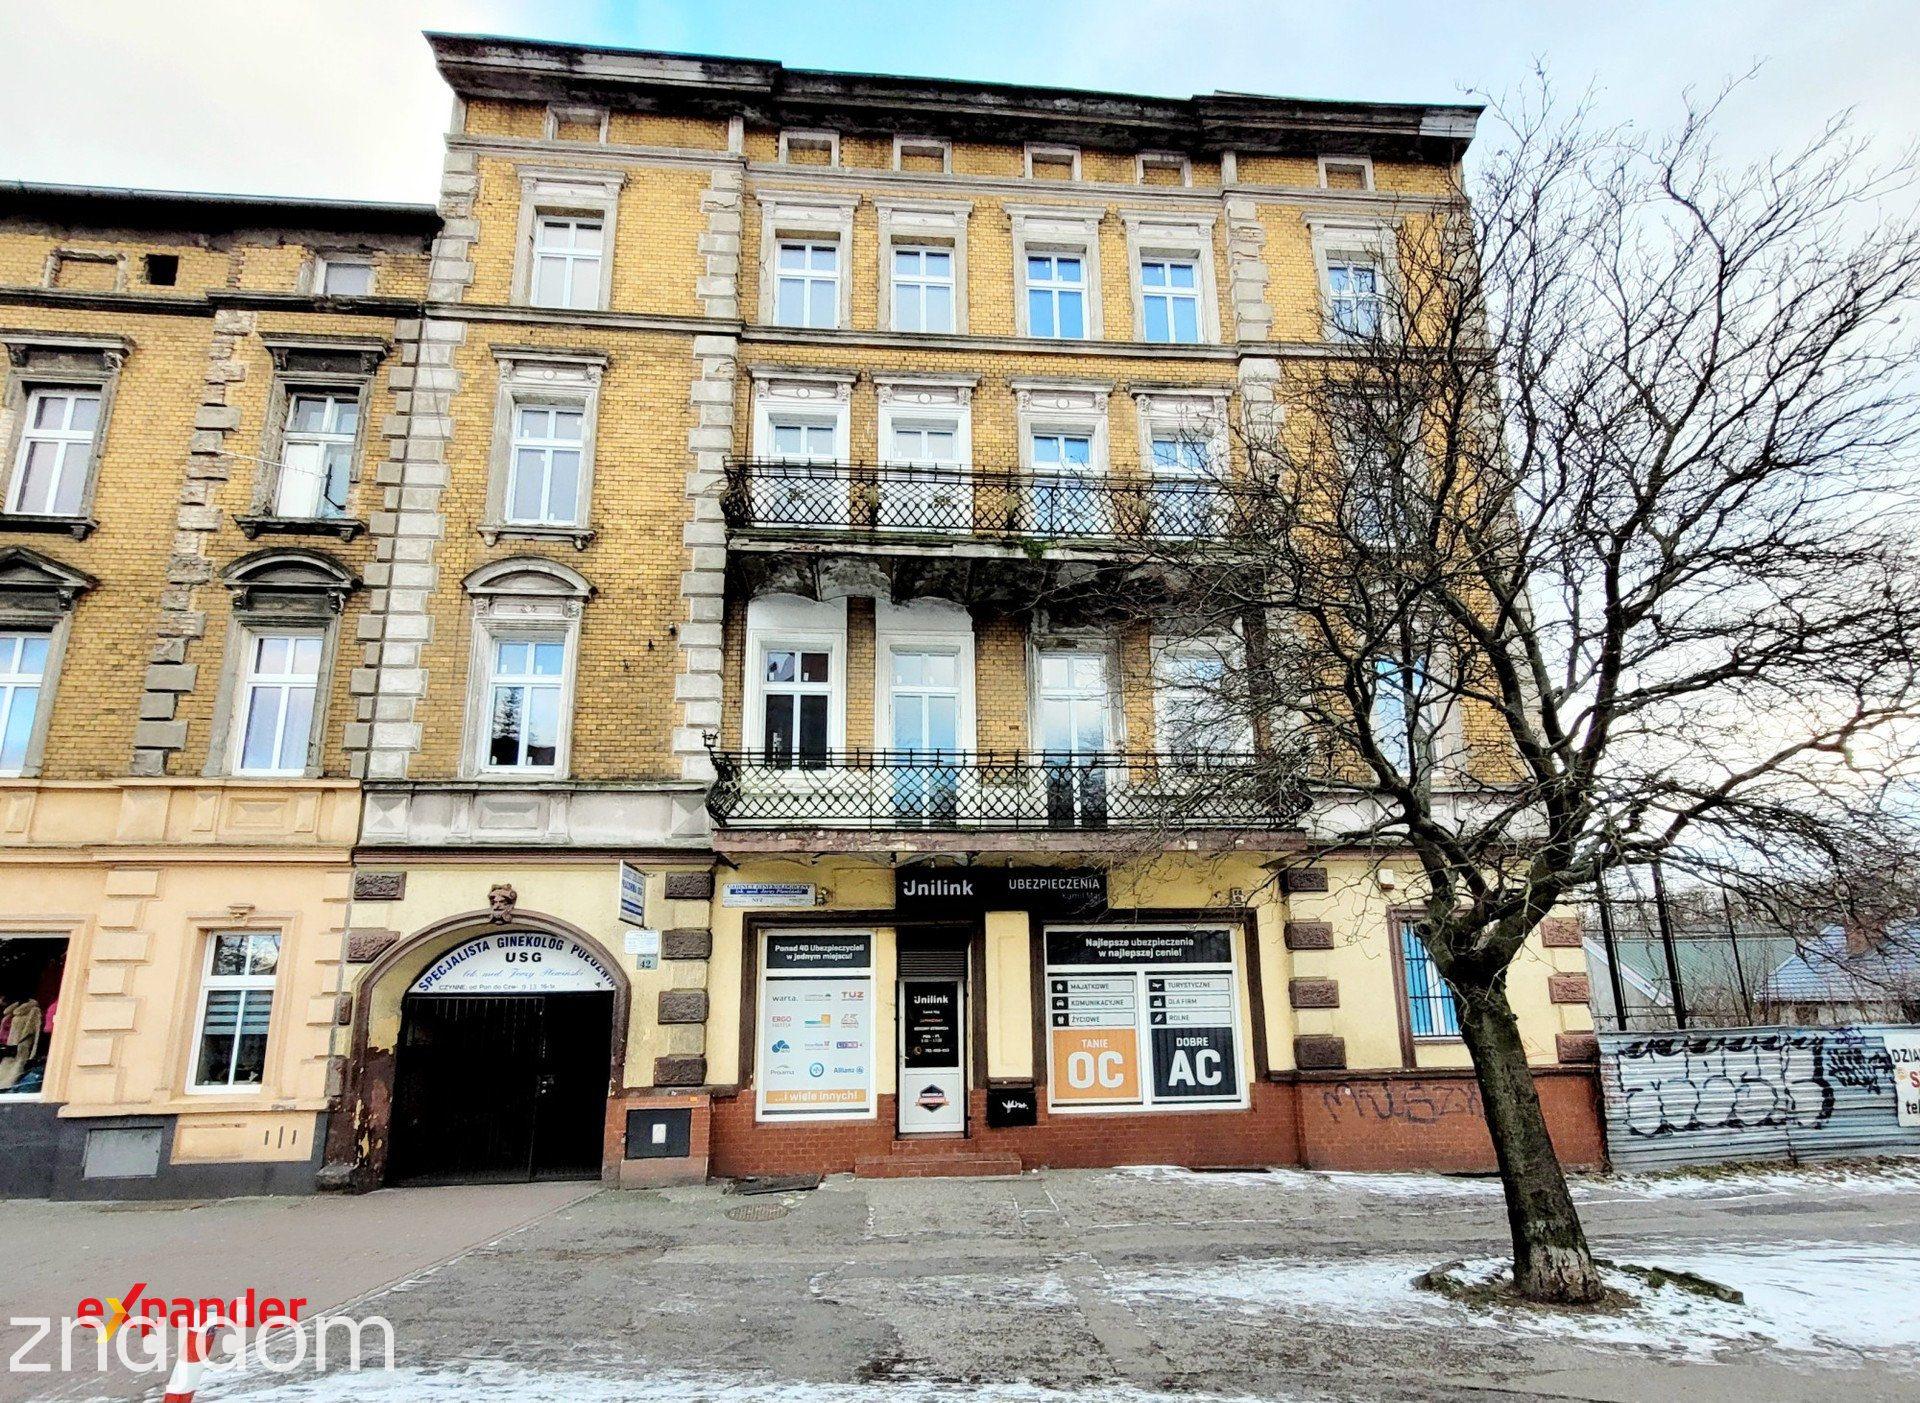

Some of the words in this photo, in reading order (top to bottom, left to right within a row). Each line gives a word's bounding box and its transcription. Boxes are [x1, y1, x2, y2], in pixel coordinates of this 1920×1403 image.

[1009, 878, 1100, 890] UBEZPIECZENIA
[775, 944, 798, 952] Ponad
[800, 944, 809, 952] 40
[1086, 938, 1129, 948] Najlepsze
[1131, 938, 1194, 948] ubezpieczenia
[505, 952, 542, 963] USG
[794, 953, 821, 961] jednym
[822, 953, 853, 961] miejscu!
[1108, 949, 1154, 959] najlepszej
[1155, 949, 1182, 957] cenie!
[419, 940, 490, 991] SPECJALISTA
[497, 936, 564, 951] GINEKOLOG
[640, 960, 652, 969] 42
[772, 1015, 792, 1023] ERGO
[1071, 1015, 1100, 1023] ŻYCIOWE
[1081, 1038, 1109, 1048] TANIE
[1176, 1036, 1210, 1047] DOBRE
[1892, 1048, 1920, 1063] DZIA
[1067, 1051, 1125, 1089] OC
[1168, 1049, 1222, 1087] AC
[789, 1091, 817, 1101] wiele
[819, 1090, 857, 1101] innych!
